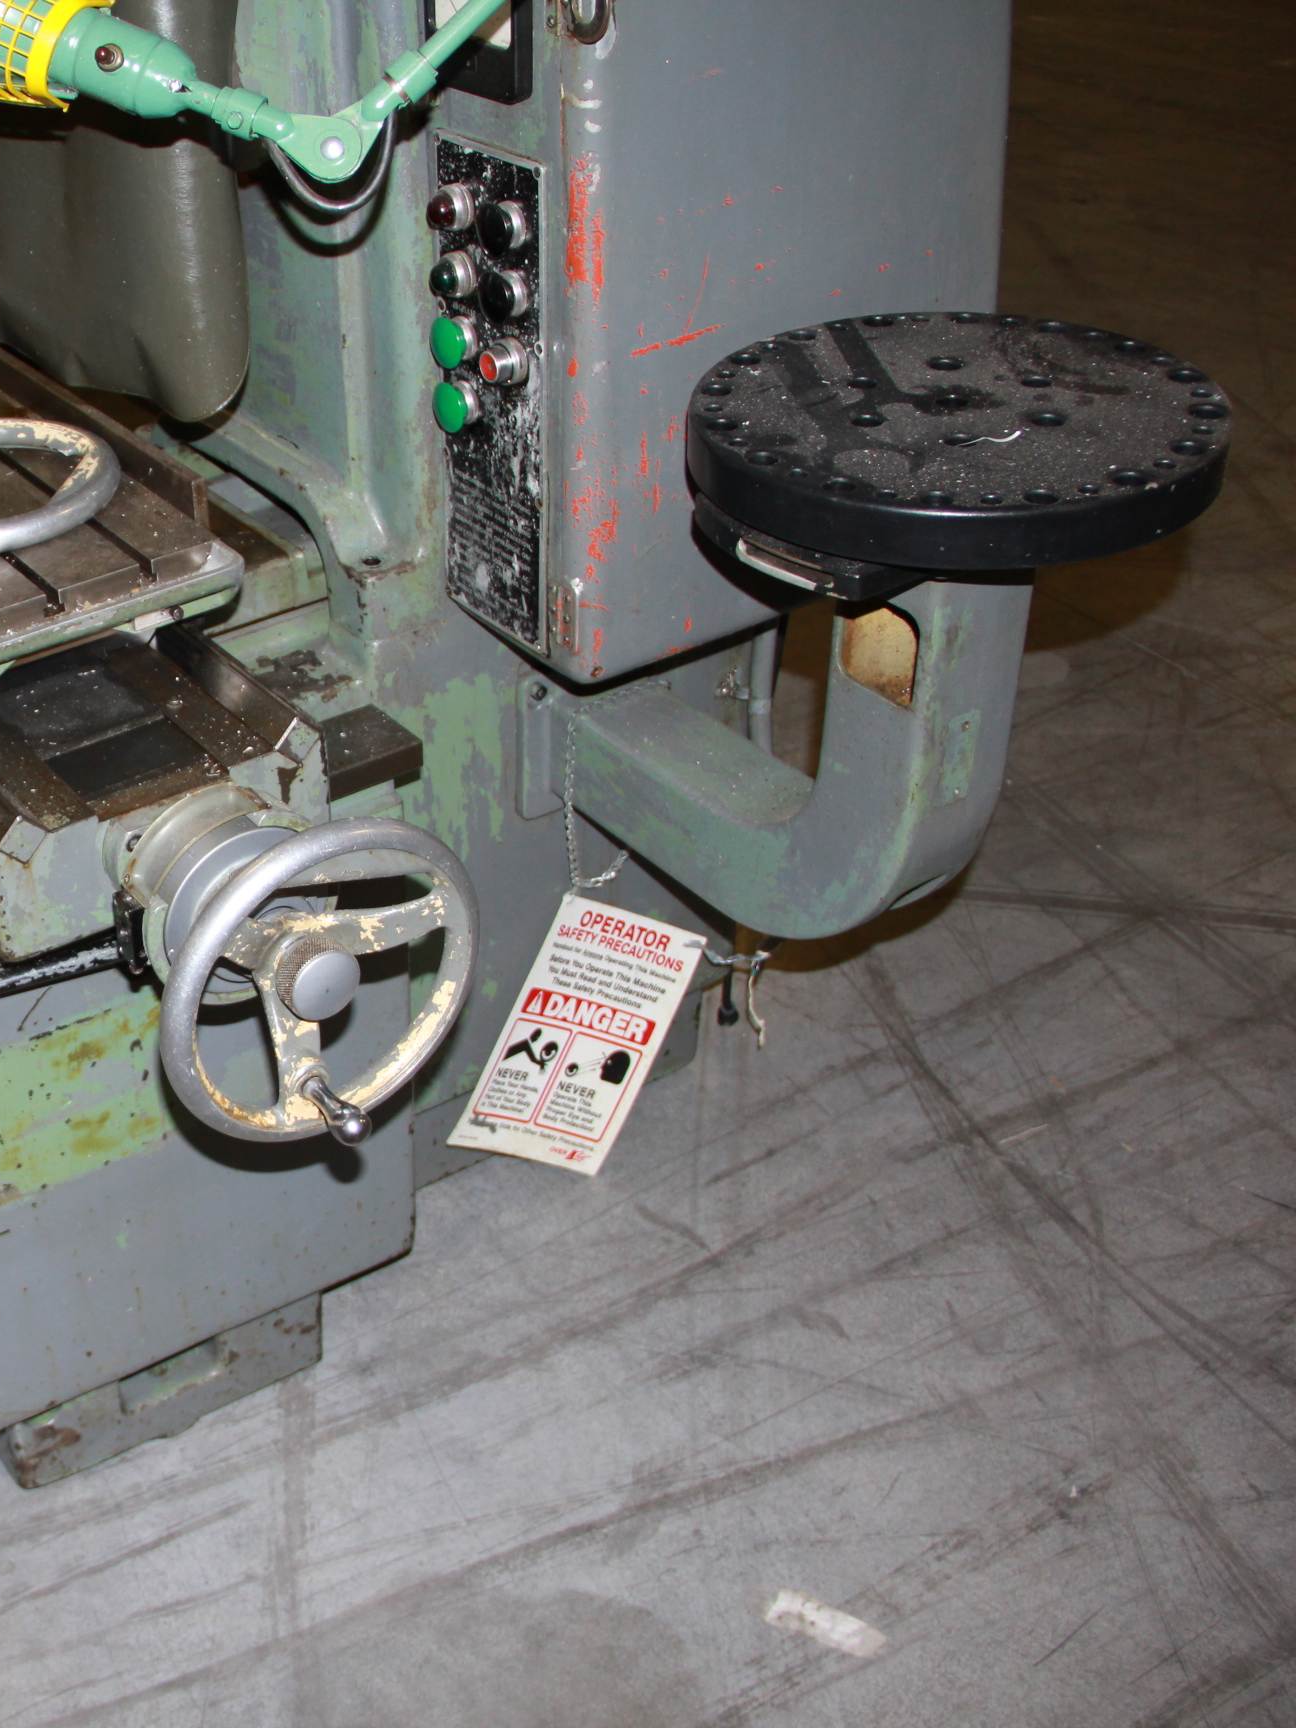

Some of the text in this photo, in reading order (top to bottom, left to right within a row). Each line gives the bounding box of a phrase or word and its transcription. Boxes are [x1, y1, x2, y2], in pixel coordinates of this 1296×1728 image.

[557, 924, 597, 942] SAFETY
[597, 936, 684, 972] PRECAUTIONS
[579, 911, 671, 951] OPERATOR
[543, 993, 650, 1040] DANGER
[496, 1067, 529, 1080] NEVER
[557, 1080, 597, 1098] NEVER
